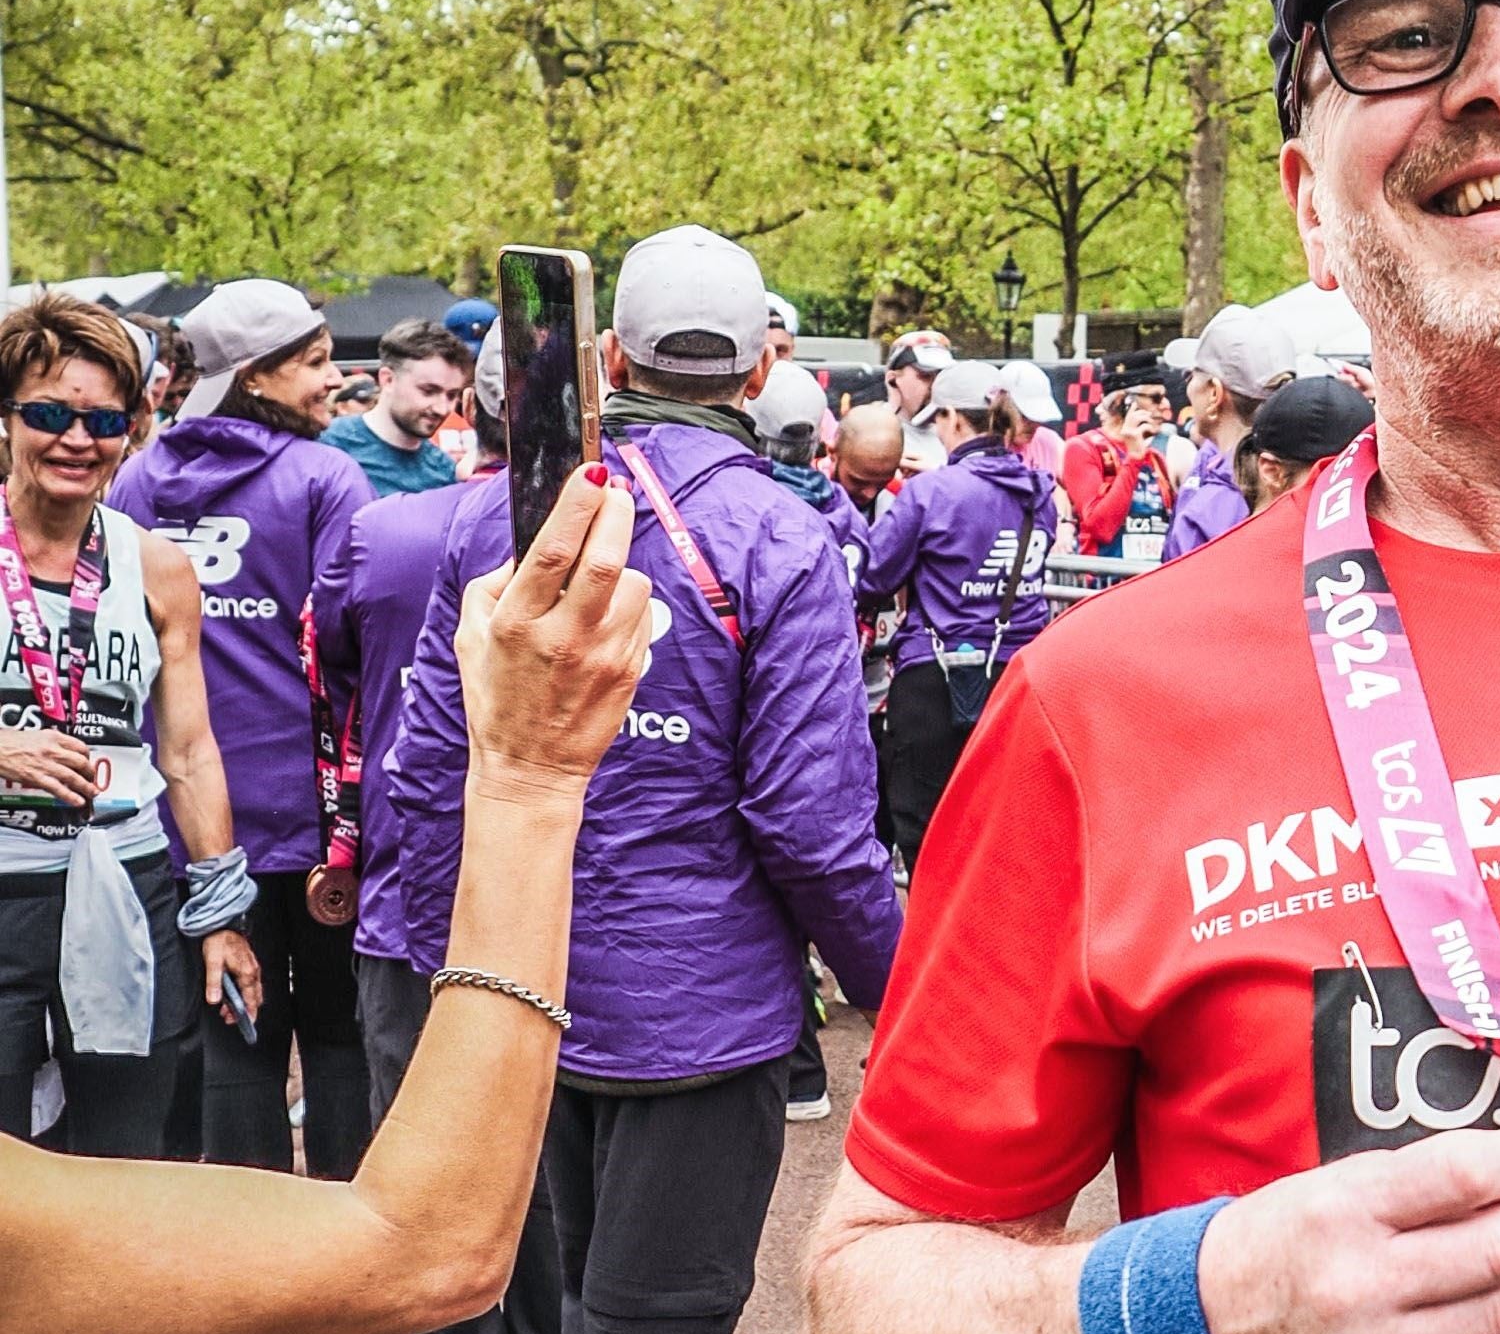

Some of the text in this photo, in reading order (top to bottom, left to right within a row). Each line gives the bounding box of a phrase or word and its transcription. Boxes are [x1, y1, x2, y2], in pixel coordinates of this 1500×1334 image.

[199, 590, 279, 620] lance
[960, 580, 996, 597] new
[12, 599, 47, 649] 2024
[1315, 560, 1402, 711] 2024
[321, 767, 340, 814] 2024
[1372, 739, 1423, 812] tcs
[1184, 805, 1365, 916] DKM
[1190, 913, 1234, 944] WE
[1239, 887, 1334, 930] DELETE
